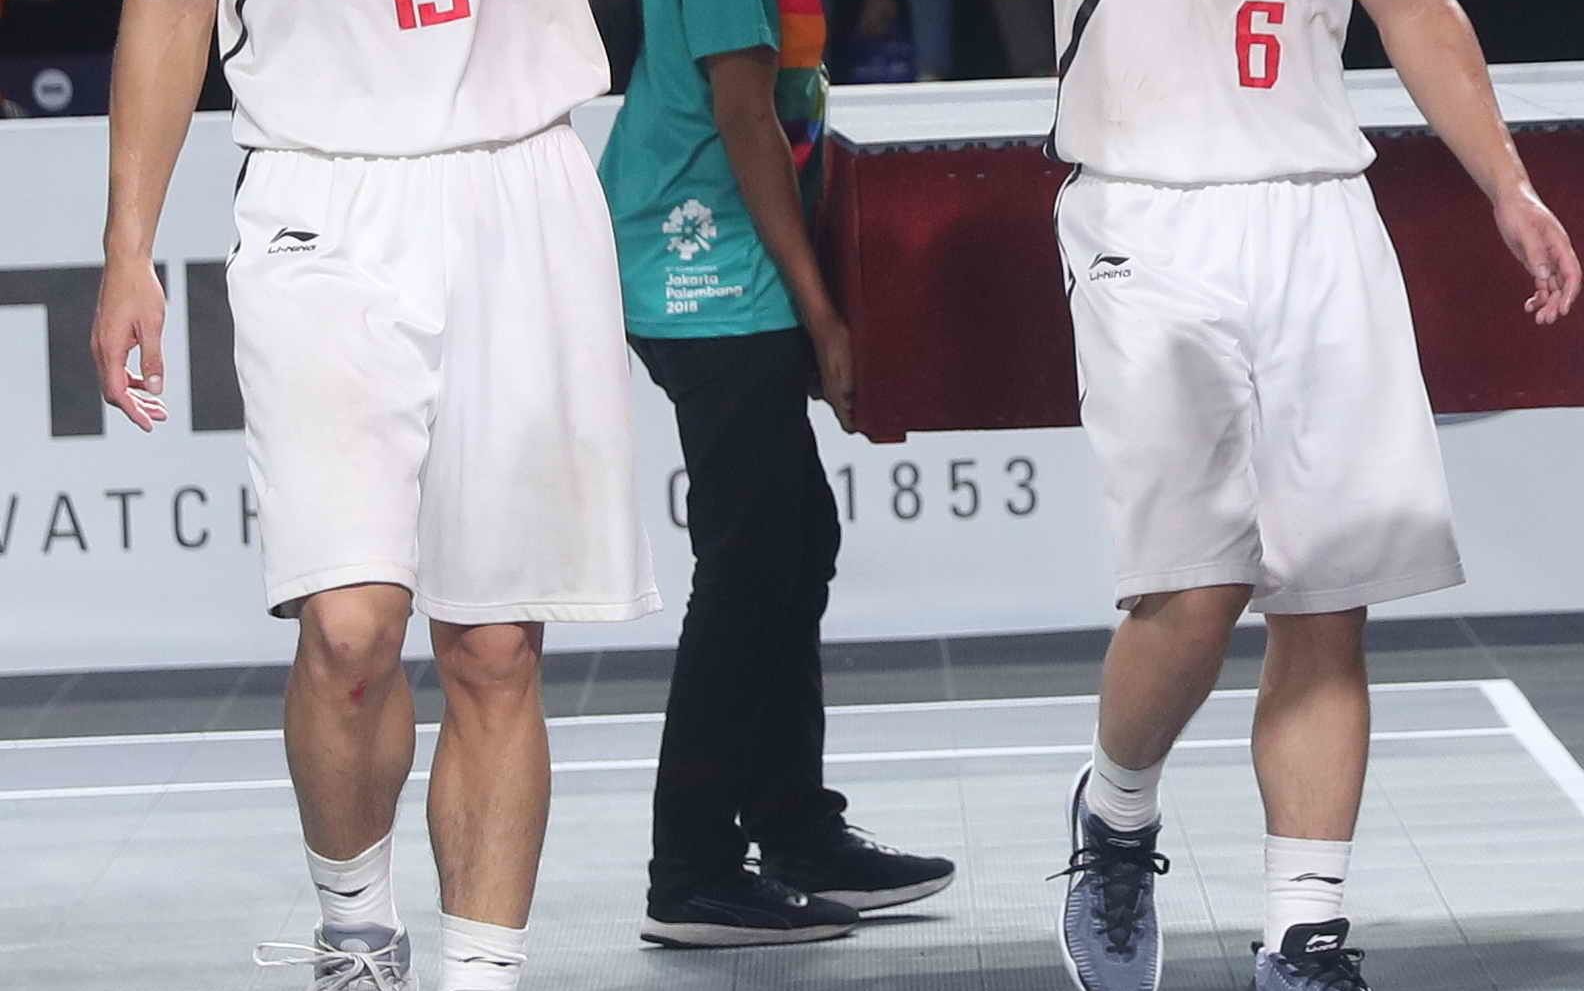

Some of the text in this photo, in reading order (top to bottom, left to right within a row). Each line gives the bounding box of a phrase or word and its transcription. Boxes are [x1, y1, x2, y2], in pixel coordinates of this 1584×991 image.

[1235, 0, 1285, 89] 6
[665, 273, 719, 286] Jakarta
[666, 285, 743, 300] Palembang
[666, 300, 698, 314] 2018
[836, 456, 1038, 522] 1853
